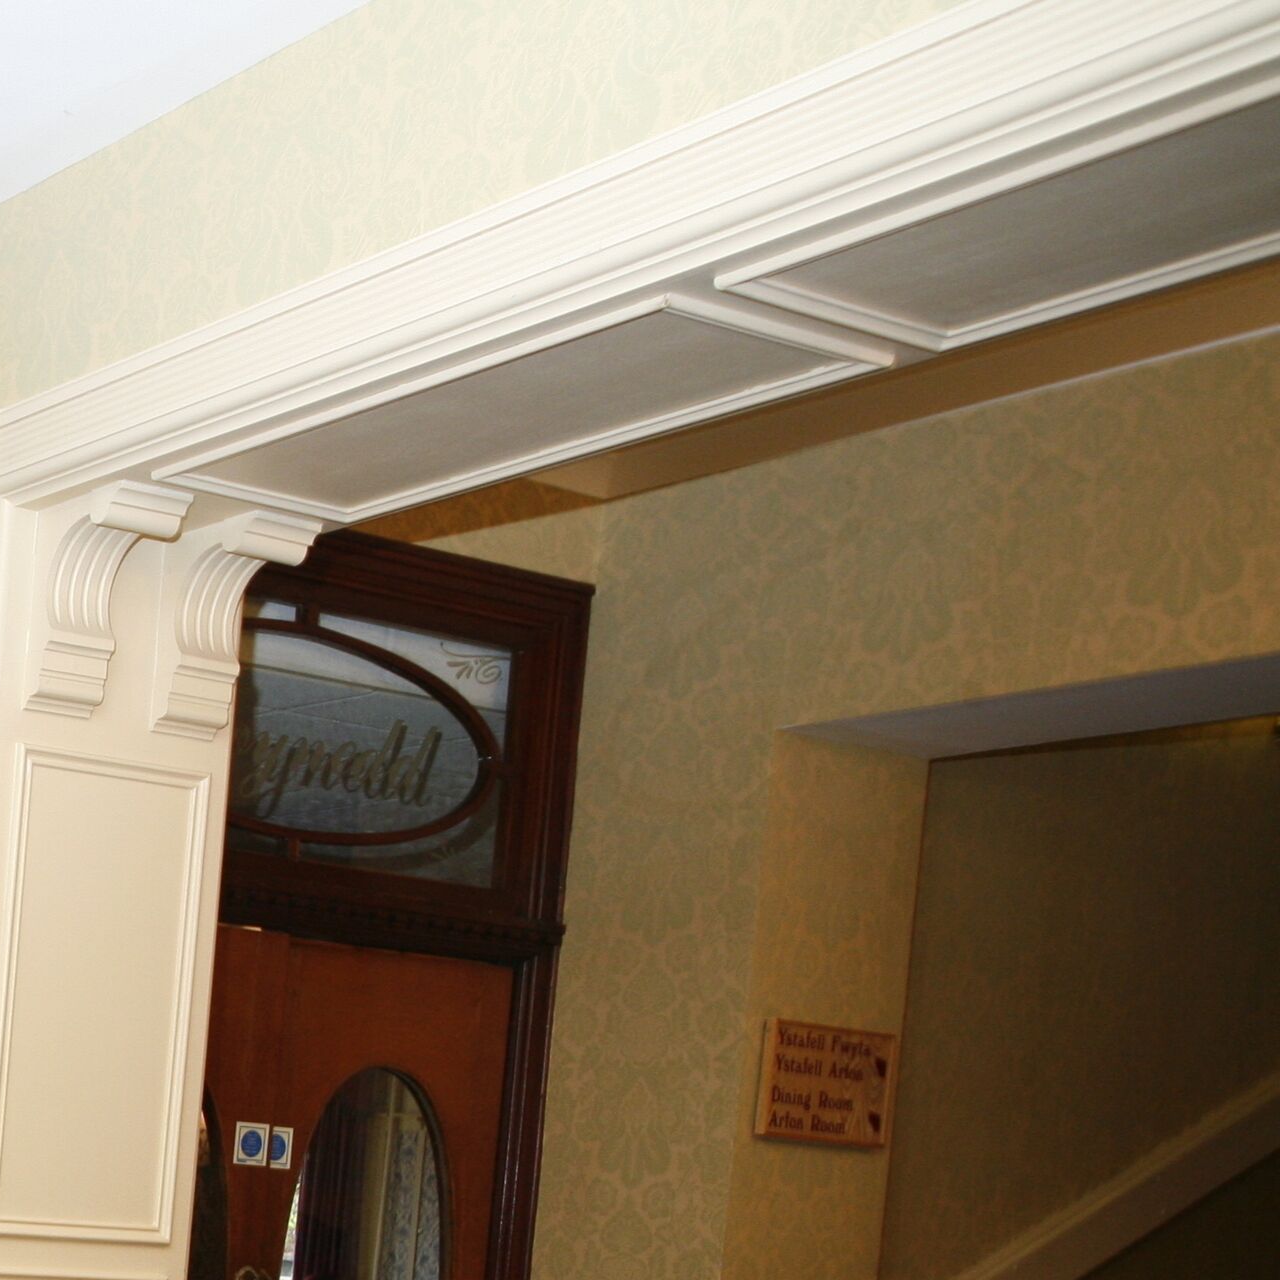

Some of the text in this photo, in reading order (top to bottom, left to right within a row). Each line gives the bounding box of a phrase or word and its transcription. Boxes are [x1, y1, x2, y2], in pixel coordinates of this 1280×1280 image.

[778, 1026, 871, 1059] Ystafell Fwyta
[775, 1053, 864, 1081] Ystafell Arfon
[771, 1084, 853, 1112] Dining Room
[768, 1109, 845, 1135] Arfon Room
